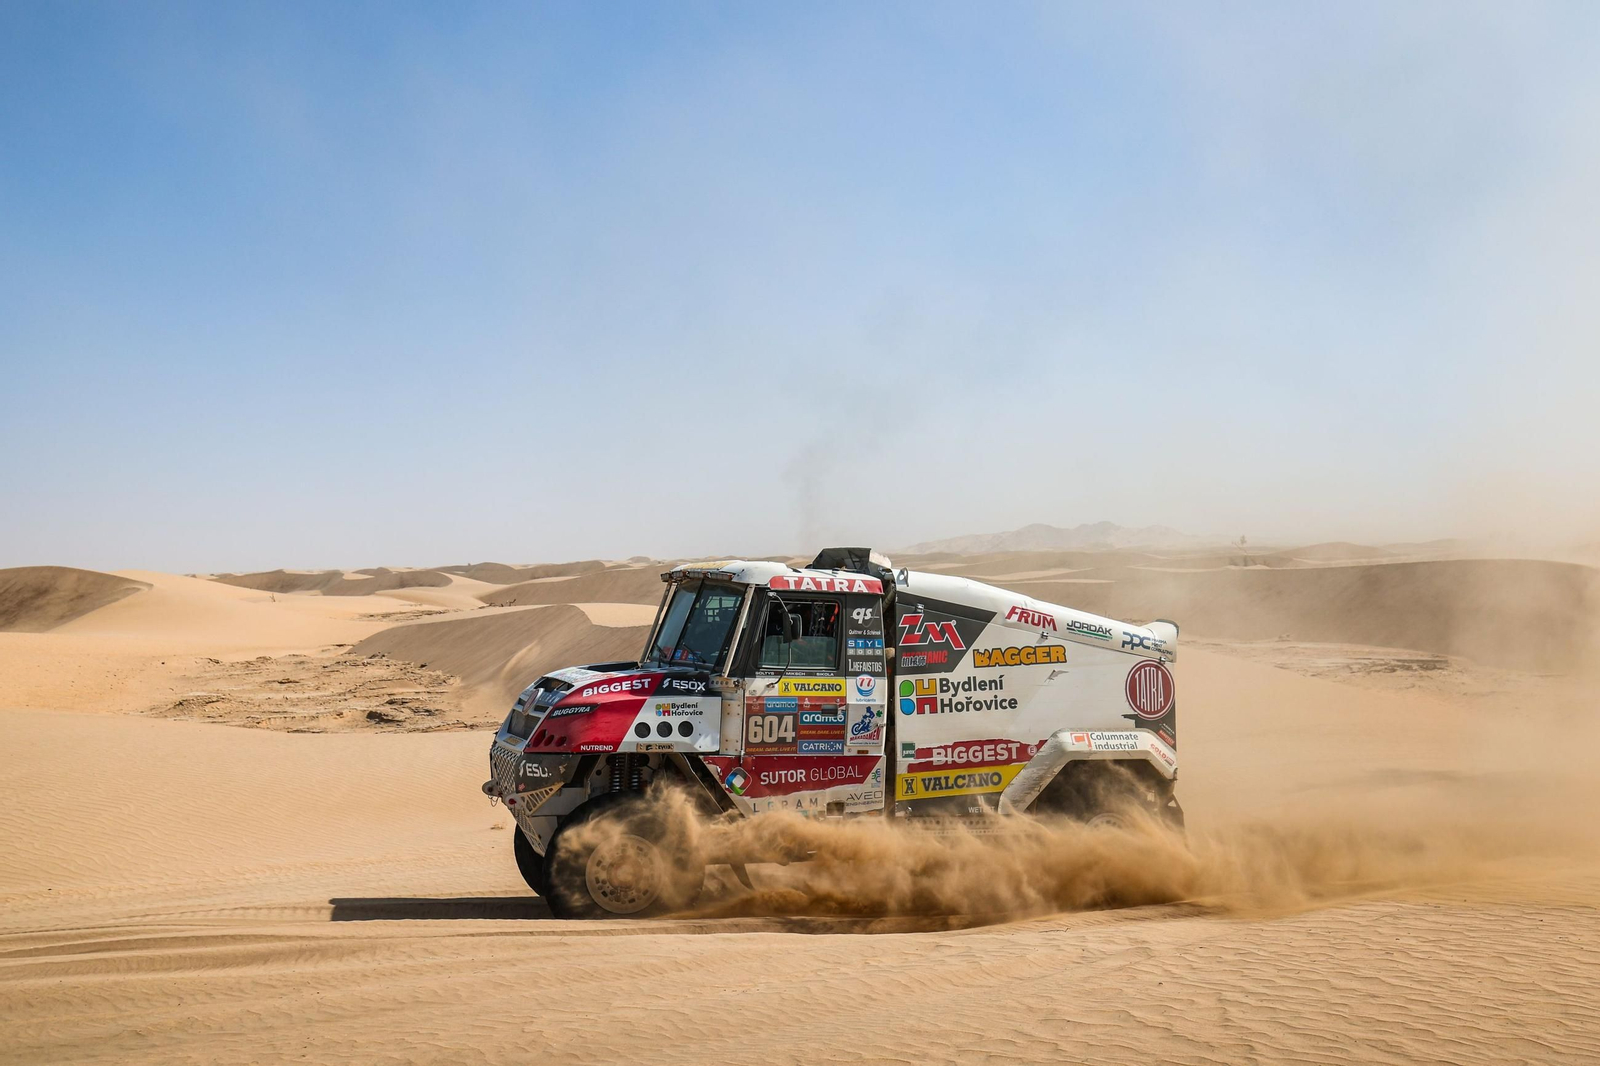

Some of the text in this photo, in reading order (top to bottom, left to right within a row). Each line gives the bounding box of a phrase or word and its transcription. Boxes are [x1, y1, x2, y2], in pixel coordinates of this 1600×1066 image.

[783, 577, 869, 593] TATRA
[1005, 605, 1058, 632] FRUM
[1121, 631, 1151, 650] PPC
[972, 644, 1067, 668] BAGGER
[582, 678, 652, 698] BIGGEST
[672, 679, 706, 692] ESOX
[793, 683, 842, 692] VALCANO
[858, 678, 872, 687] 77
[939, 674, 1005, 698] Bydlení
[1134, 666, 1164, 712] TATRA
[552, 705, 591, 717] BUGGYRA
[671, 702, 698, 710] Bydlení
[940, 694, 1018, 714] Hořovice
[748, 715, 796, 744] 604
[1090, 732, 1139, 741] Columnate
[932, 743, 1020, 766] BIGGEST
[1094, 741, 1138, 750] industrial
[760, 766, 864, 786] SUTOR GLOBAL
[921, 772, 1002, 792] VALCANO
[846, 790, 884, 801] AVEO
